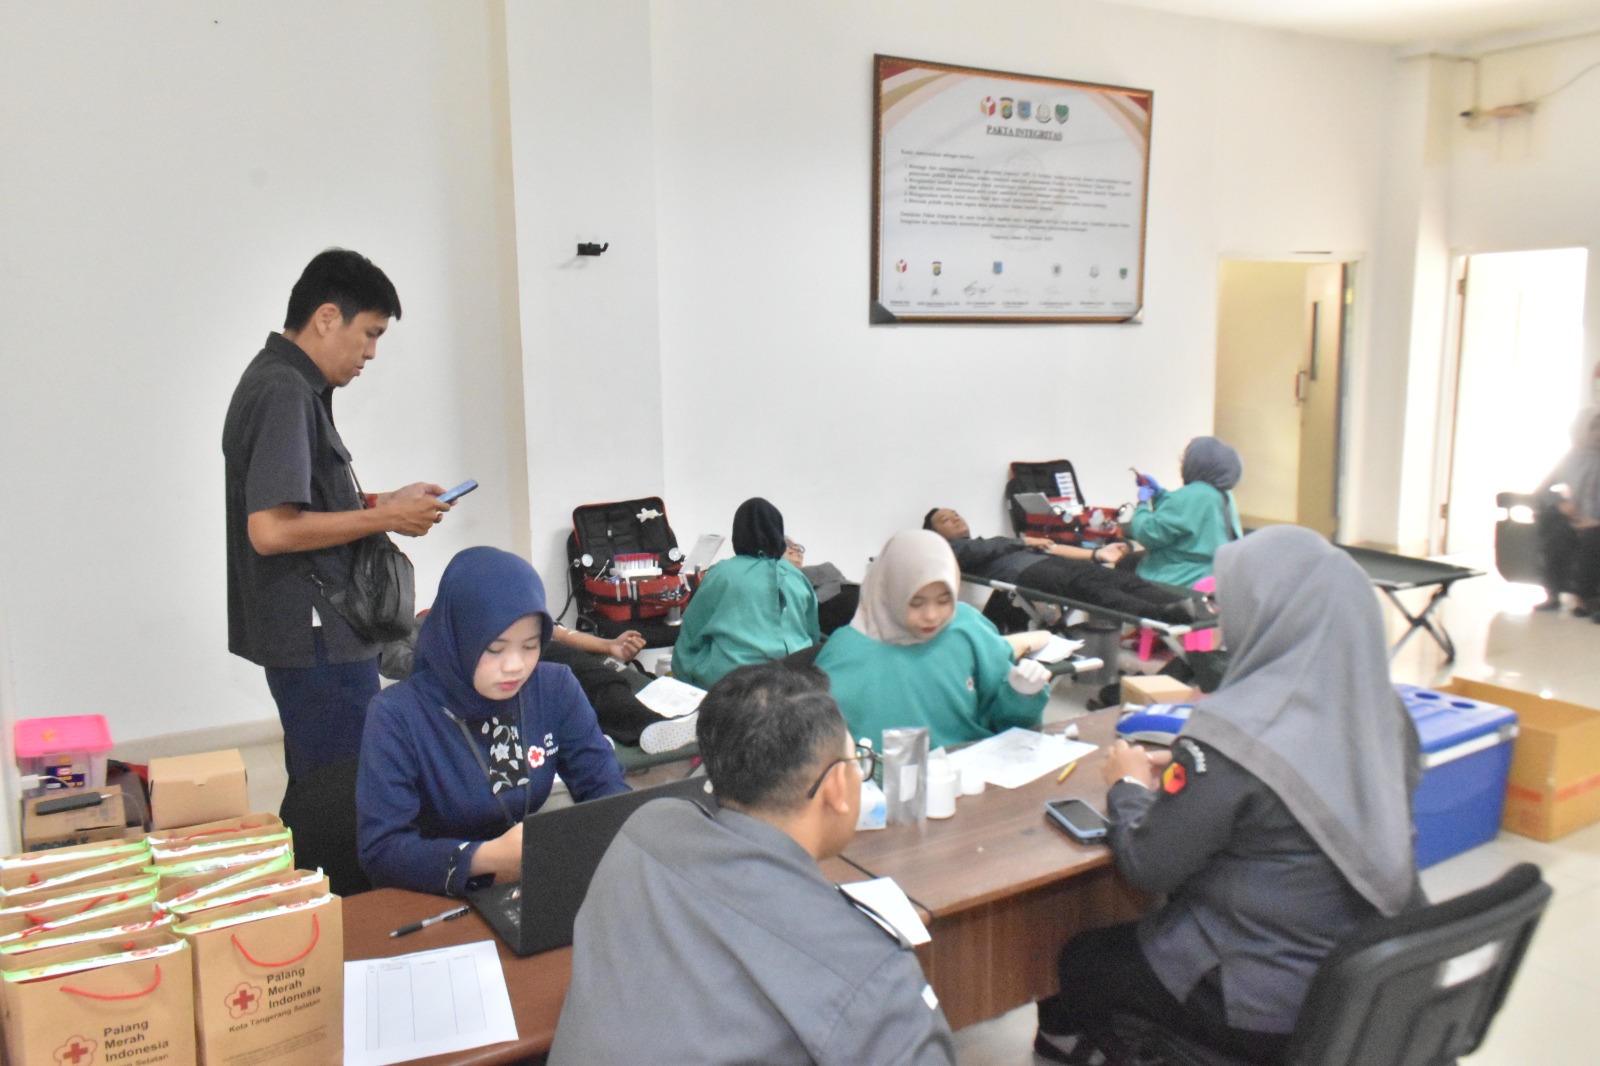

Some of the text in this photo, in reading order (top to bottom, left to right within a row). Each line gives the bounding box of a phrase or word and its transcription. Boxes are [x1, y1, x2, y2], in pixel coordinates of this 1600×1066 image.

[987, 125, 1063, 140] PAKTA INTEGRITAS
[267, 968, 305, 984] Palang
[268, 980, 302, 997] Merah
[269, 985, 321, 1009] Indonesia
[229, 998, 321, 1033] Kota Tangerang Selatan
[104, 1021, 149, 1037] Palang
[105, 1033, 145, 1049] Merah
[105, 1040, 169, 1062] Indonesia
